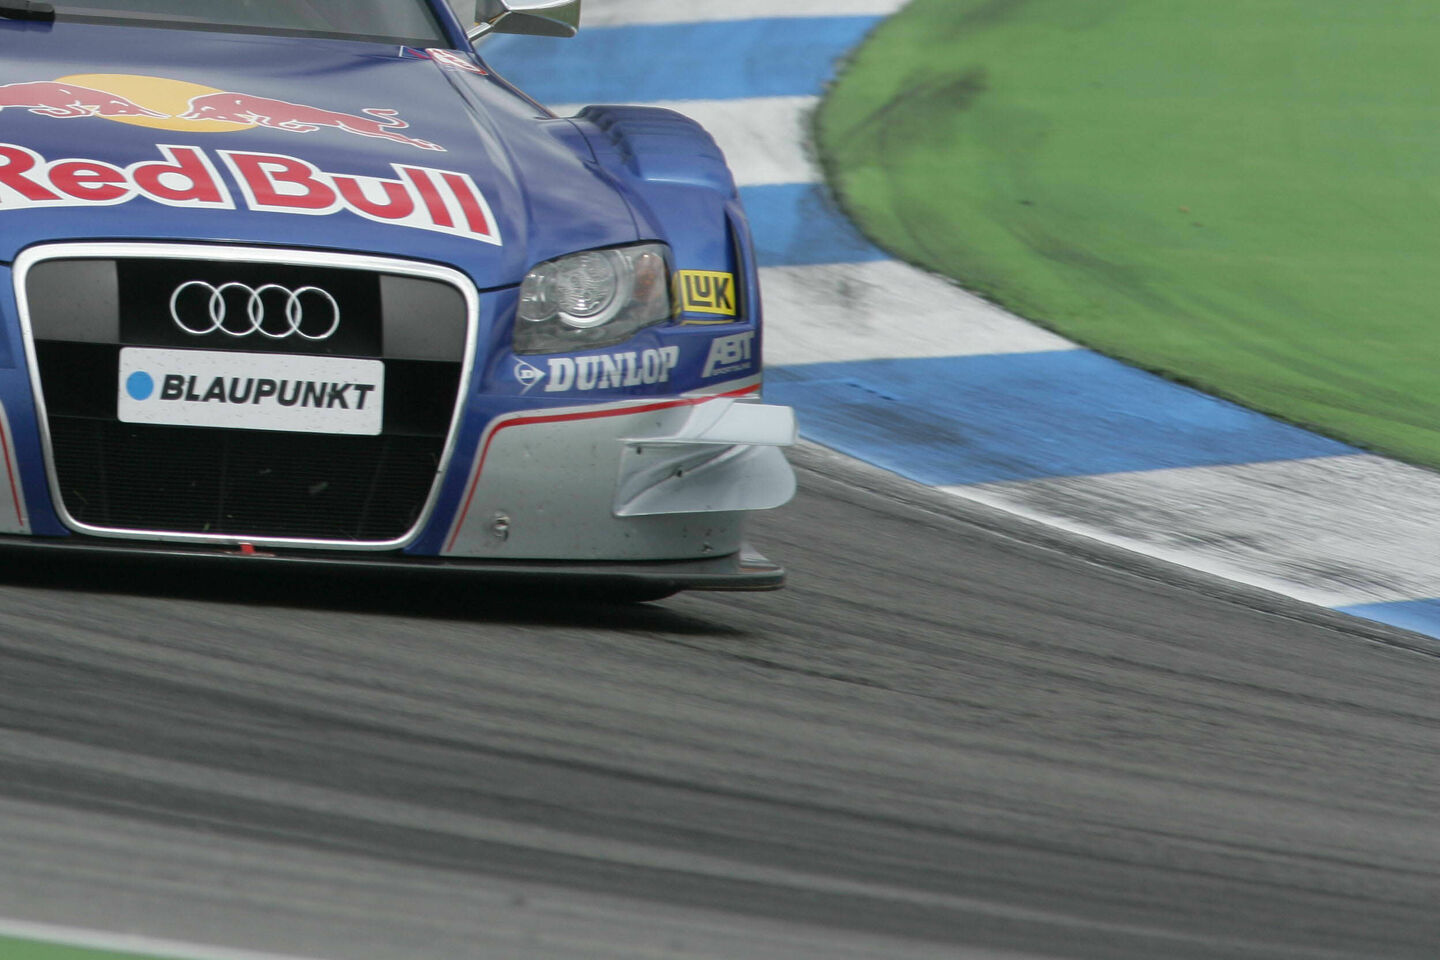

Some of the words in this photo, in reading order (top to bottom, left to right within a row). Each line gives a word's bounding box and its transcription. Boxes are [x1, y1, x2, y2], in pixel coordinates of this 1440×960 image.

[218, 149, 502, 246] Bull
[545, 345, 680, 392] DUNLOP
[702, 331, 755, 378] ABT
[159, 374, 376, 412] BLAUPUNKT
